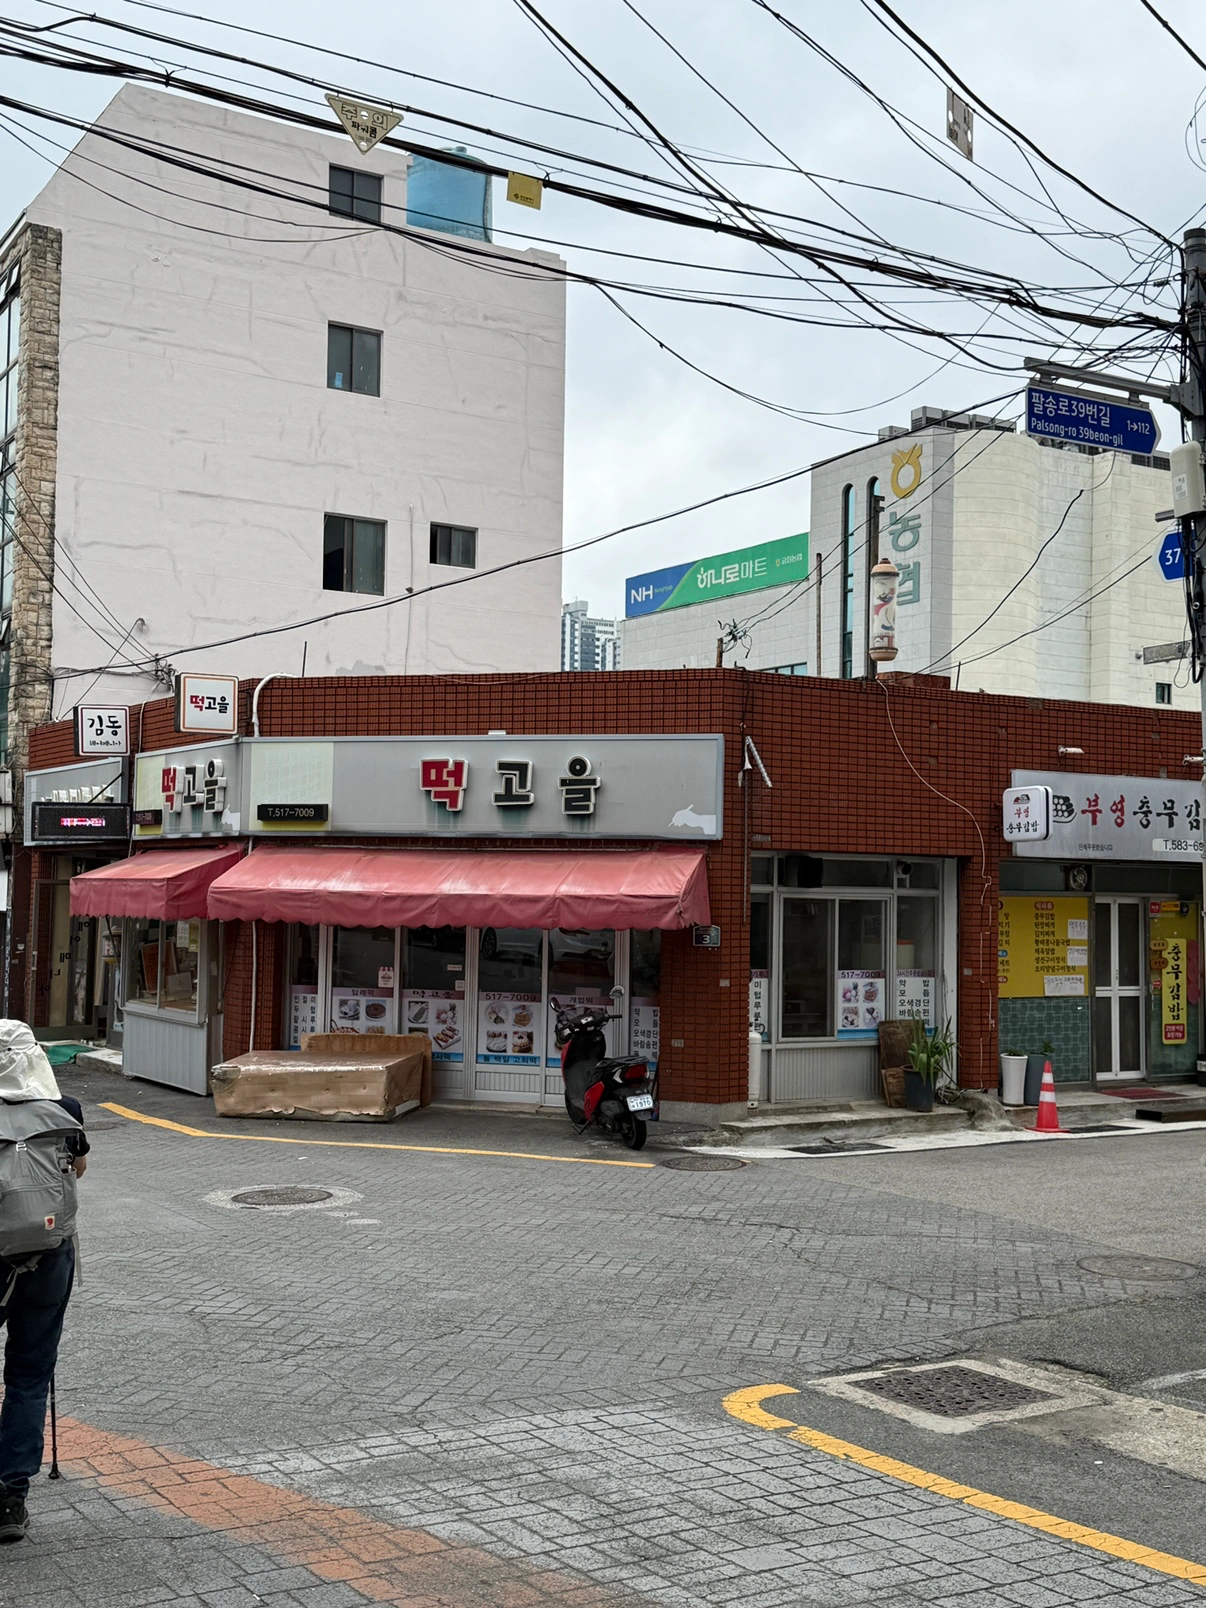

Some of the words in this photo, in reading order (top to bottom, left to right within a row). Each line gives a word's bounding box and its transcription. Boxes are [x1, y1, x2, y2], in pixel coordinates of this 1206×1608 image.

[1031, 392, 1111, 428] 팔송로39번길
[1031, 417, 1077, 438] Palsong-ro
[1078, 427, 1124, 446] 39beon-gil
[1165, 549, 1181, 565] 37
[697, 557, 767, 589] 하나로마트
[631, 585, 654, 604] NH
[190, 694, 230, 714] 떡고을
[87, 715, 122, 736] 김동
[162, 760, 224, 813] 떡고을
[421, 756, 600, 814] 떡고을
[267, 808, 315, 818] T.517-7009
[1014, 806, 1030, 818] 부영
[1081, 794, 1126, 828] 부영
[1006, 820, 1040, 834] 충무김밥
[1034, 921, 1055, 929] 된장찌개
[1034, 930, 1055, 938] 김치찌개
[702, 934, 711, 944] 3
[841, 971, 881, 979] 517-7009
[1166, 943, 1184, 1021] 충무김밥
[485, 993, 536, 1001] 517-7009
